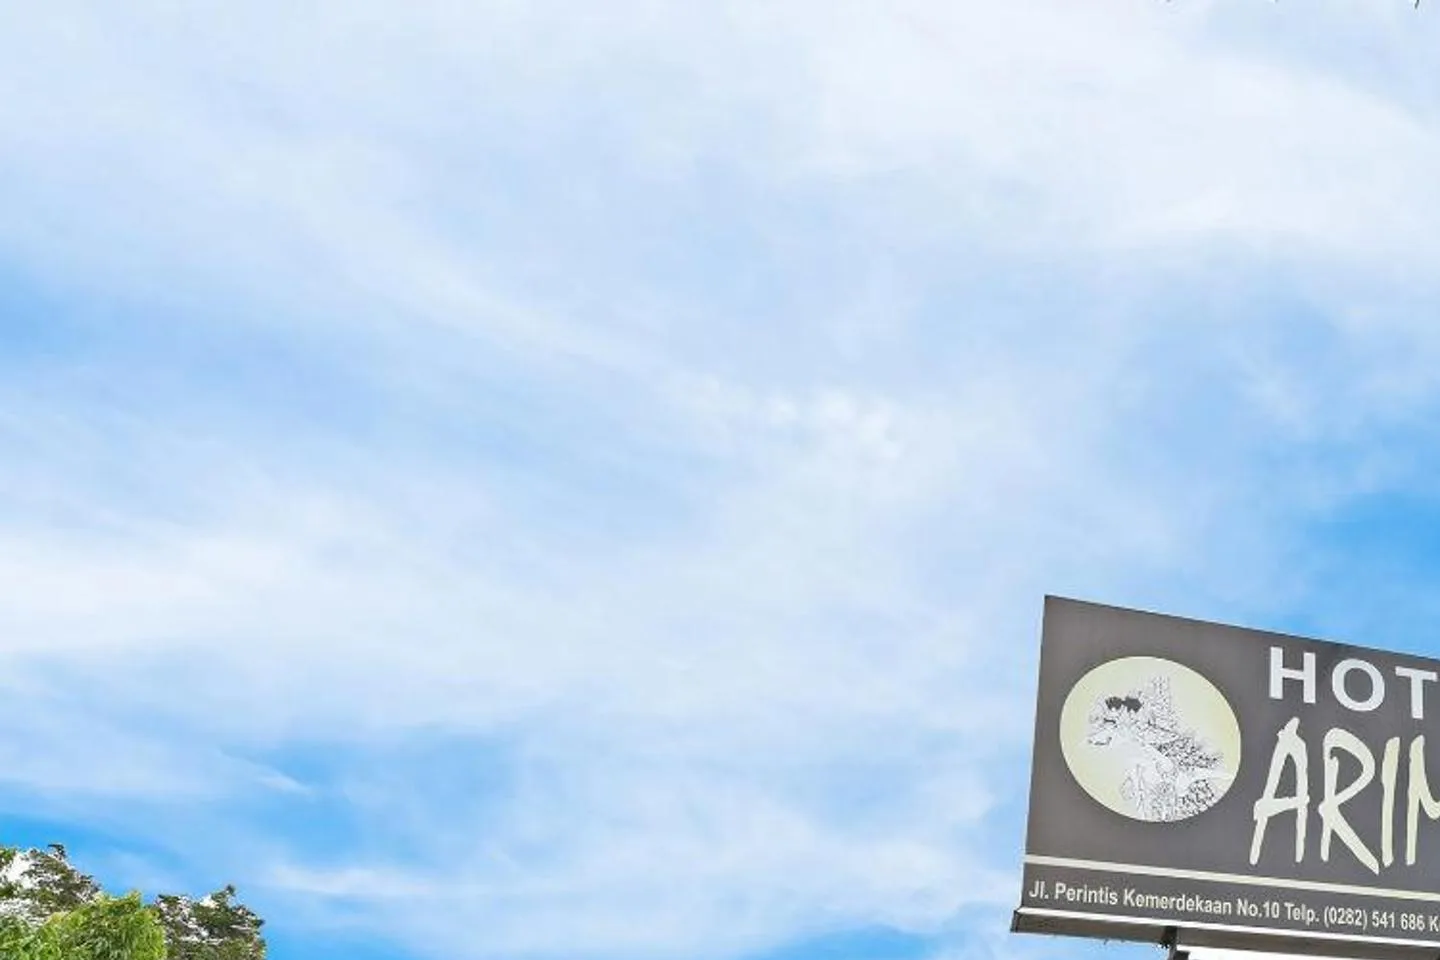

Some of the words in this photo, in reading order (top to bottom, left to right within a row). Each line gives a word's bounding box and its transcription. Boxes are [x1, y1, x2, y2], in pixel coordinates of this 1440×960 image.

[1029, 880, 1049, 900] Jl.
[1055, 882, 1118, 905] Perintis
[1123, 888, 1232, 916] Kemerdekaan
[1236, 900, 1280, 919] No.10
[1284, 902, 1319, 924] Telp.
[1324, 905, 1368, 930] (0282)
[1372, 911, 1395, 929] 541
[1400, 913, 1425, 931] 686
